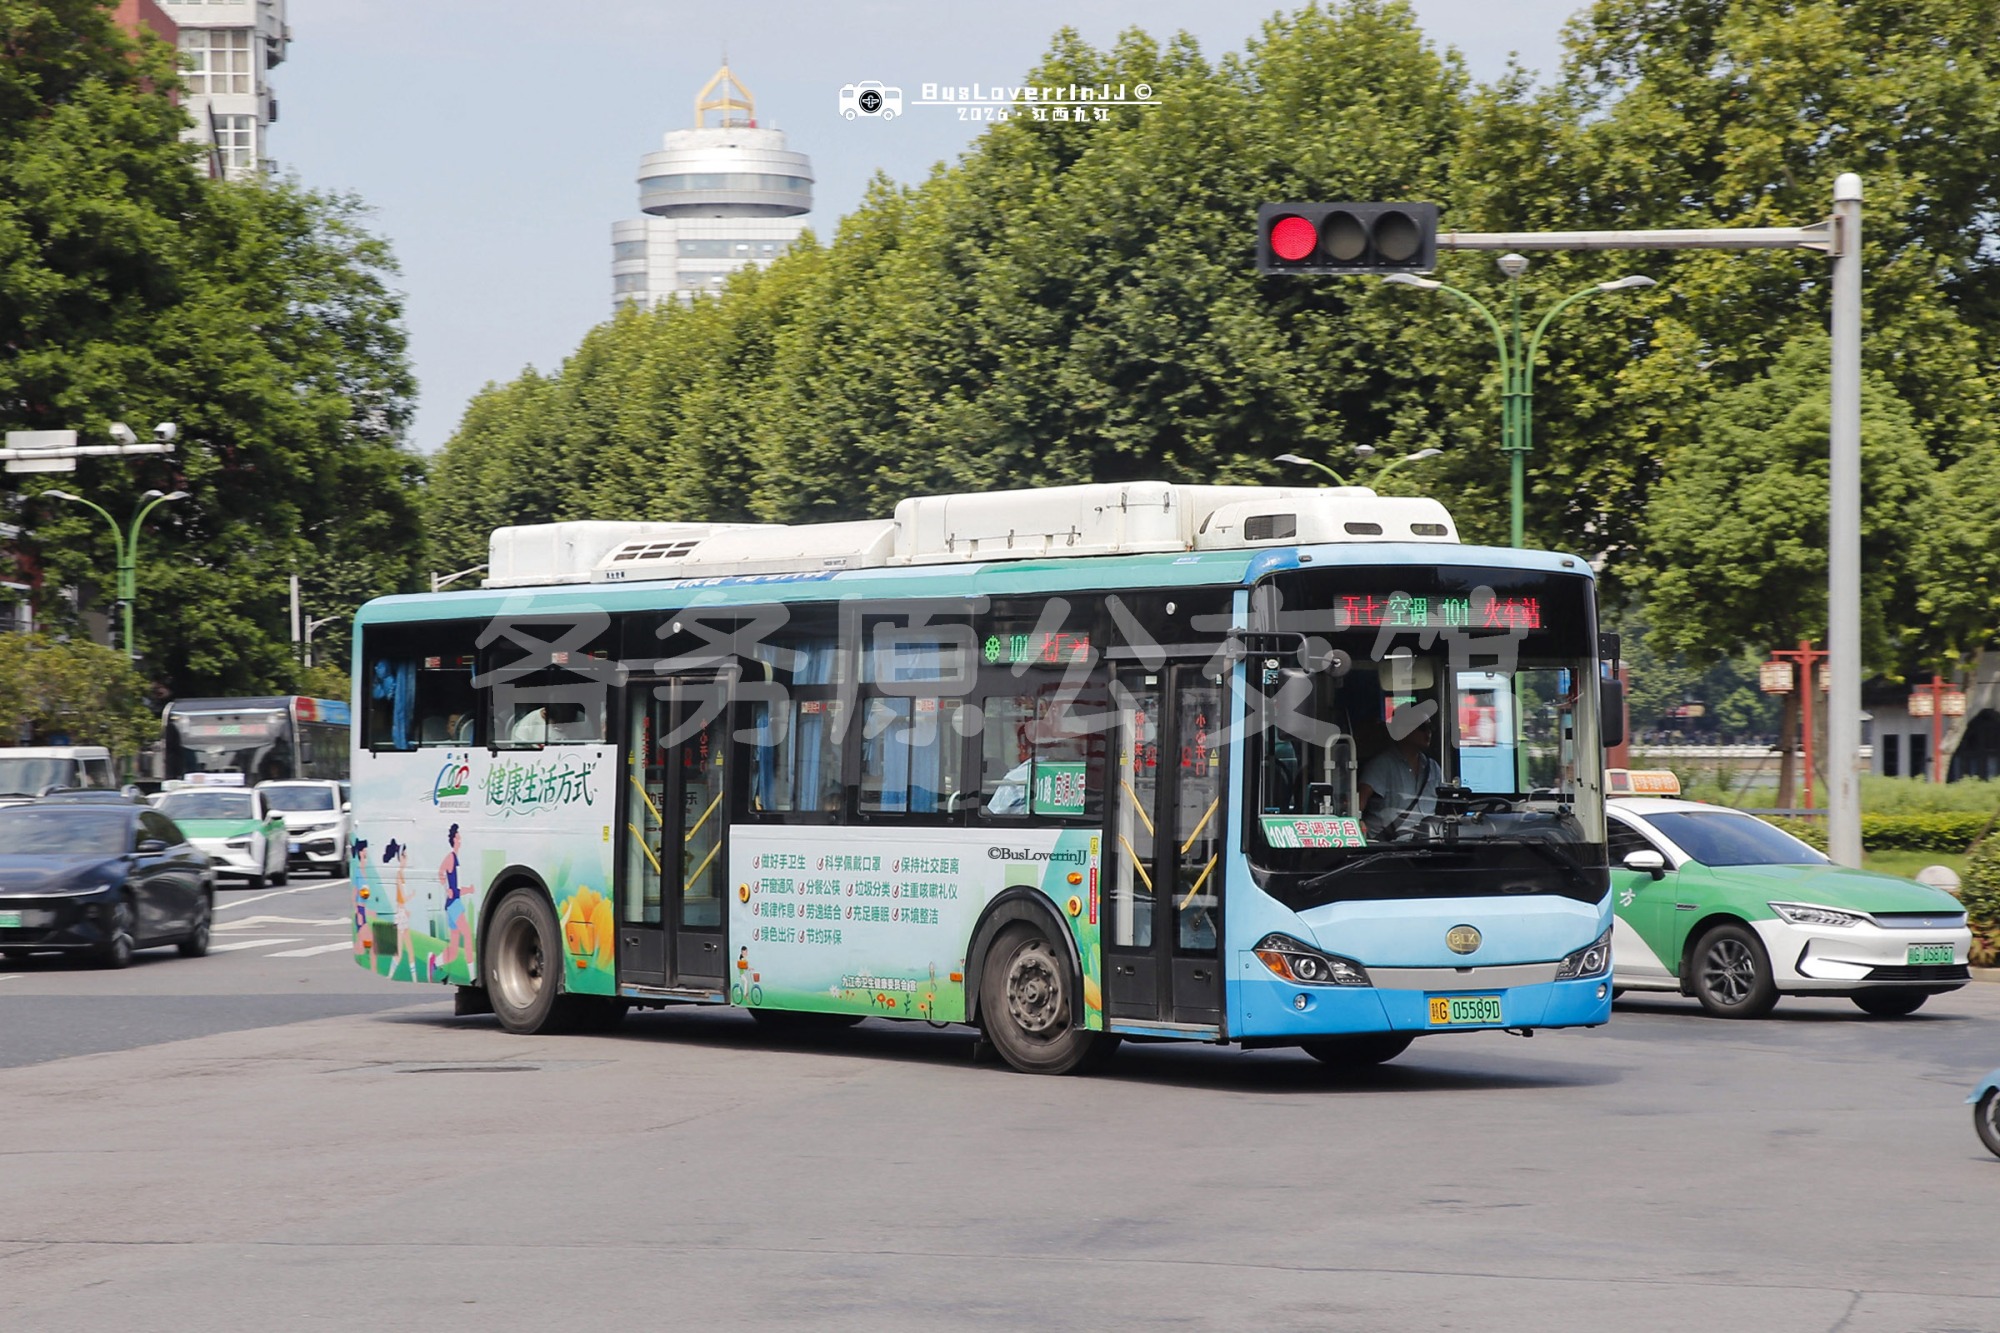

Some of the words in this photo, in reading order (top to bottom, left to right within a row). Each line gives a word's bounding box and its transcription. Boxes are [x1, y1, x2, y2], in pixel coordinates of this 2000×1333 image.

[1389, 595, 1429, 627] 空调
[1442, 598, 1470, 626] 101
[1483, 597, 1541, 629] 火车站
[1009, 635, 1028, 662] 101
[484, 762, 598, 807] 健康生活方式
[1294, 820, 1361, 837] 空调开启
[761, 854, 806, 870] 做好手卫生
[825, 855, 881, 872] 科学佩戴口罩
[901, 857, 960, 875] 保持社交距离
[761, 878, 794, 894] 开窗通风
[806, 879, 841, 896] 分餐公筷
[855, 880, 890, 897] 垃圾分类
[900, 882, 958, 900] 注重咳嗽礼仪
[761, 903, 795, 918] 规律作息
[806, 904, 841, 920] 劳逸结合
[853, 905, 889, 922] 充足睡眠
[901, 907, 939, 924] 环境整洁
[761, 926, 795, 943] 绿色出行
[806, 928, 842, 945] 节约环保
